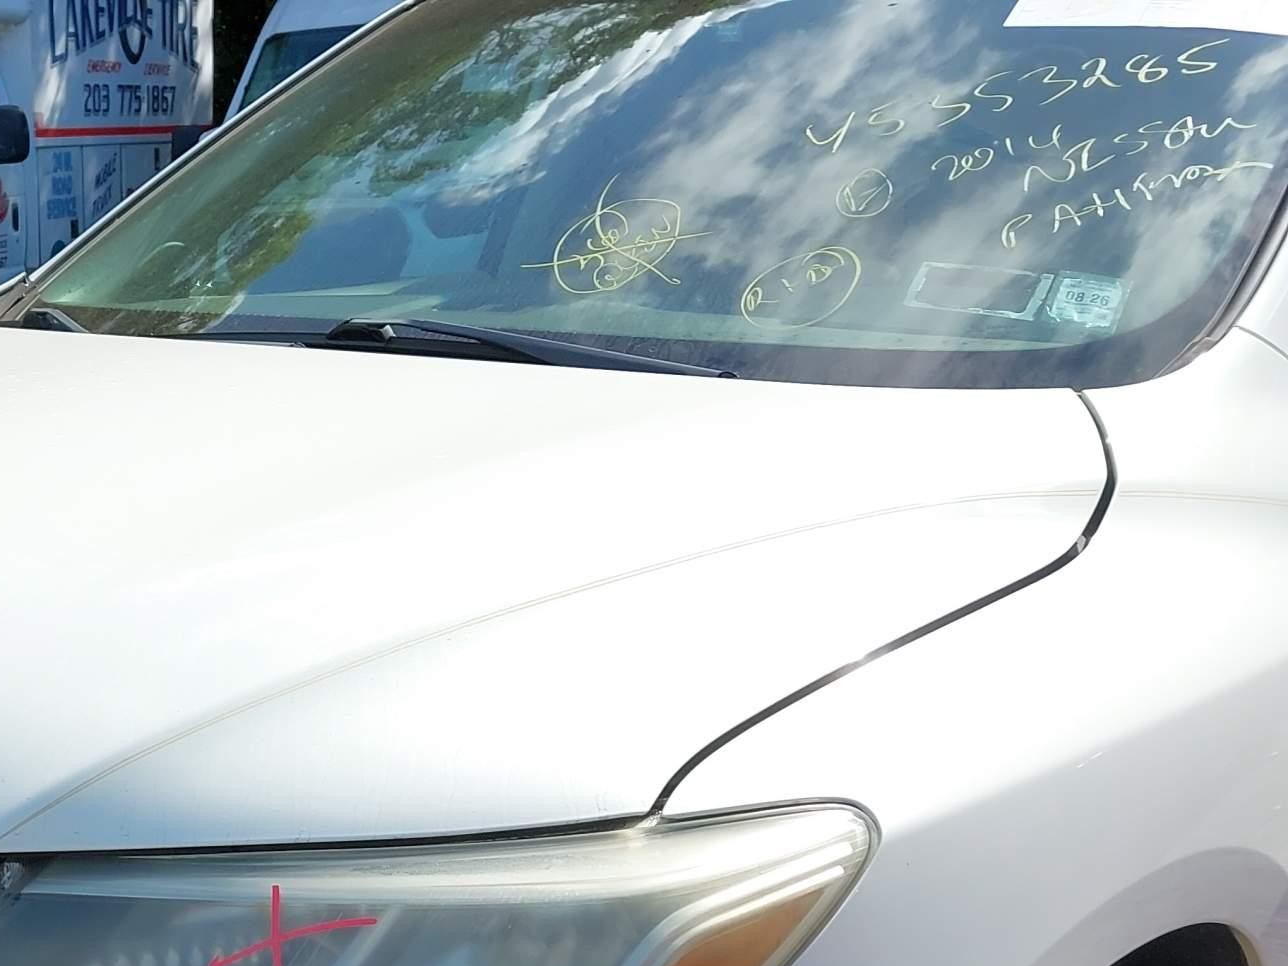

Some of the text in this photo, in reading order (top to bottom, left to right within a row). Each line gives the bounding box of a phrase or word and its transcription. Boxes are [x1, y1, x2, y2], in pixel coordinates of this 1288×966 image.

[83, 83, 110, 116] 203
[1065, 289, 1111, 307] 08 26
